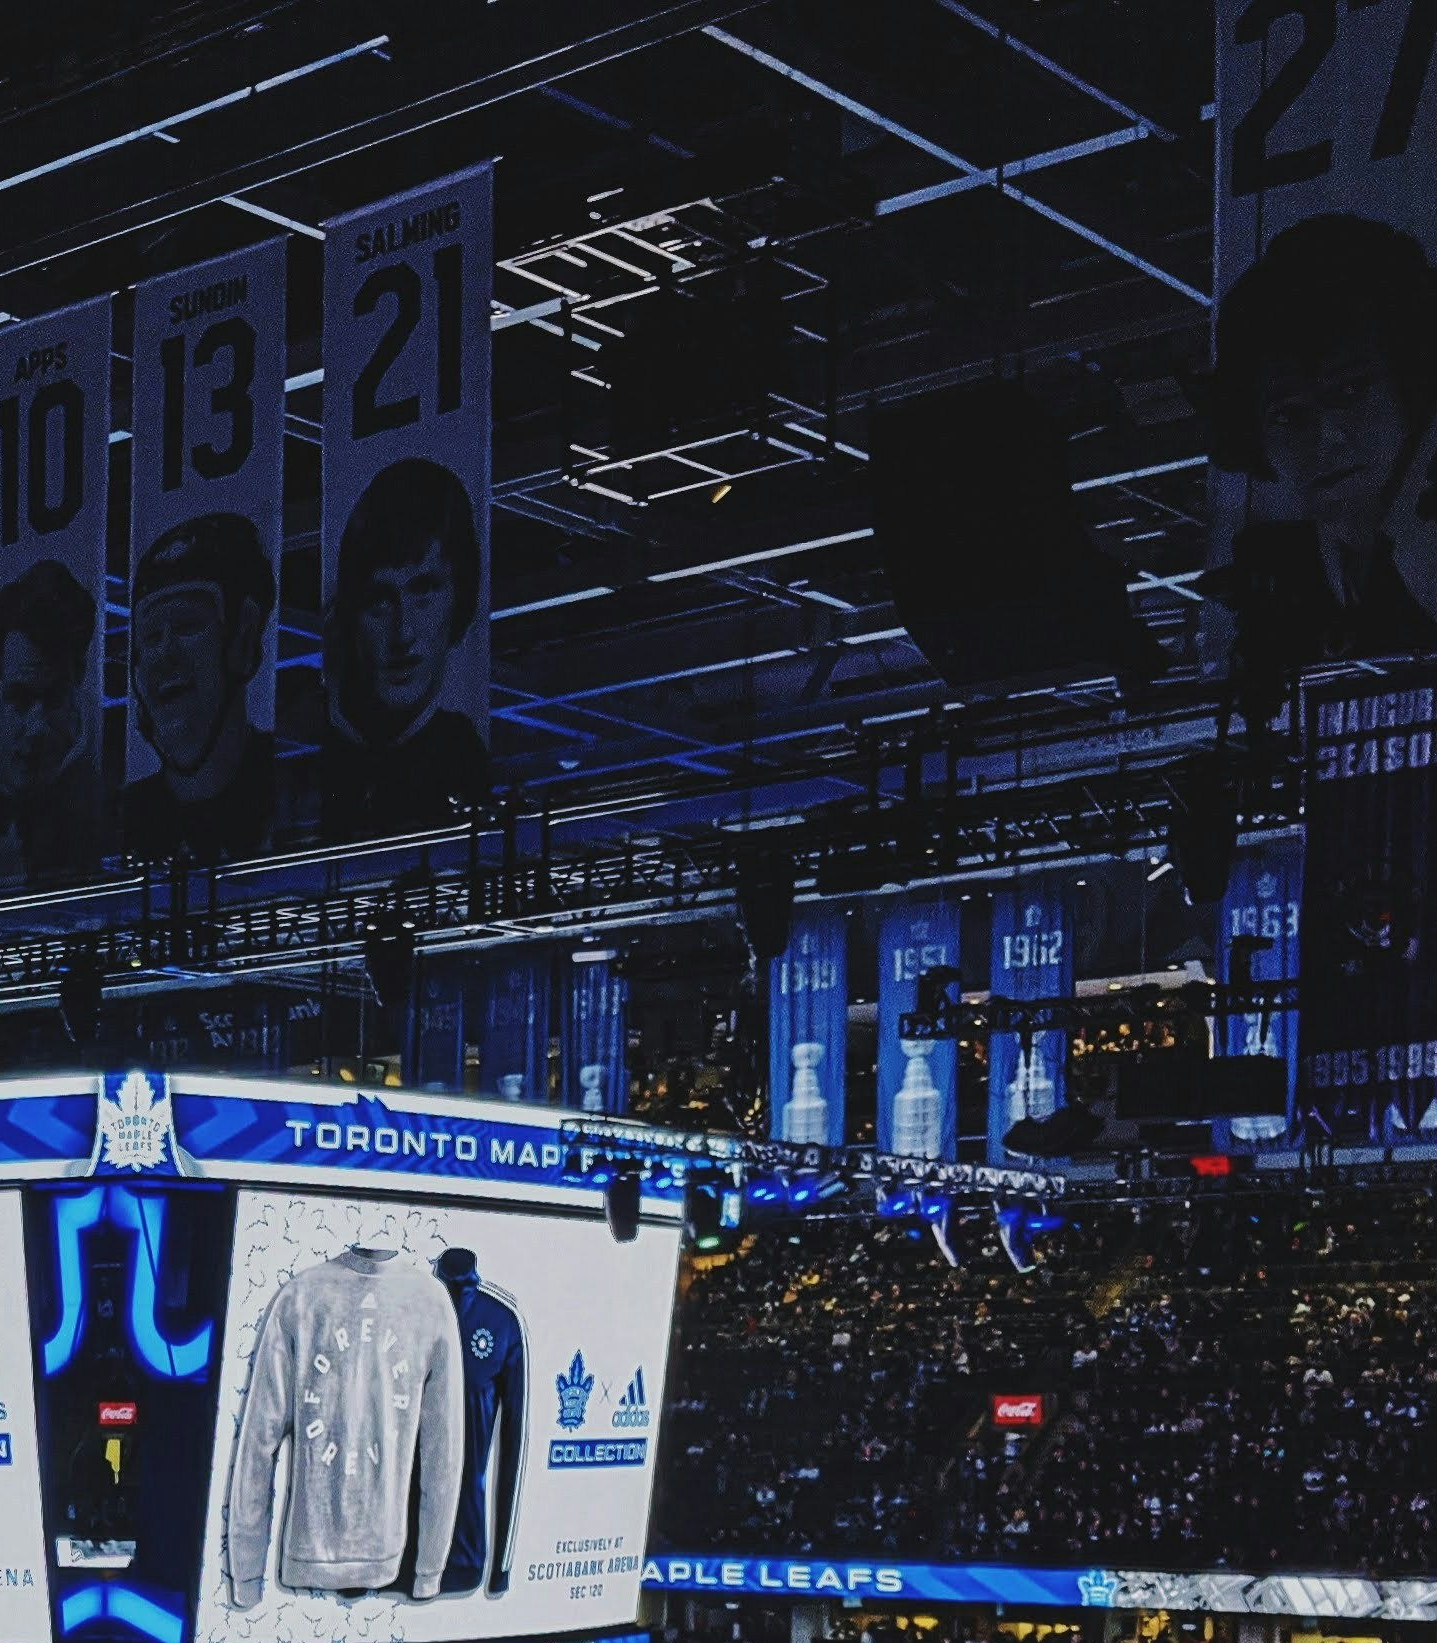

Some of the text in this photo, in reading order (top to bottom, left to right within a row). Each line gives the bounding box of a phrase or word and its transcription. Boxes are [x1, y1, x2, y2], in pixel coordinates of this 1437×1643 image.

[1231, 0, 1436, 196] 27
[354, 200, 461, 264] SALMING
[169, 275, 249, 324] SUNDIN
[13, 341, 68, 382] APPS
[352, 243, 463, 441] 21
[161, 316, 255, 492] 13
[285, 1119, 477, 1161] TORONTO
[550, 1443, 646, 1463] COLLECTION
[555, 1537, 610, 1554] EXCLUSIVELY
[527, 1559, 604, 1582] SCOTIABANK
[641, 1559, 904, 1594] APLE LEAFS
[570, 1584, 604, 1600] SEC 120
